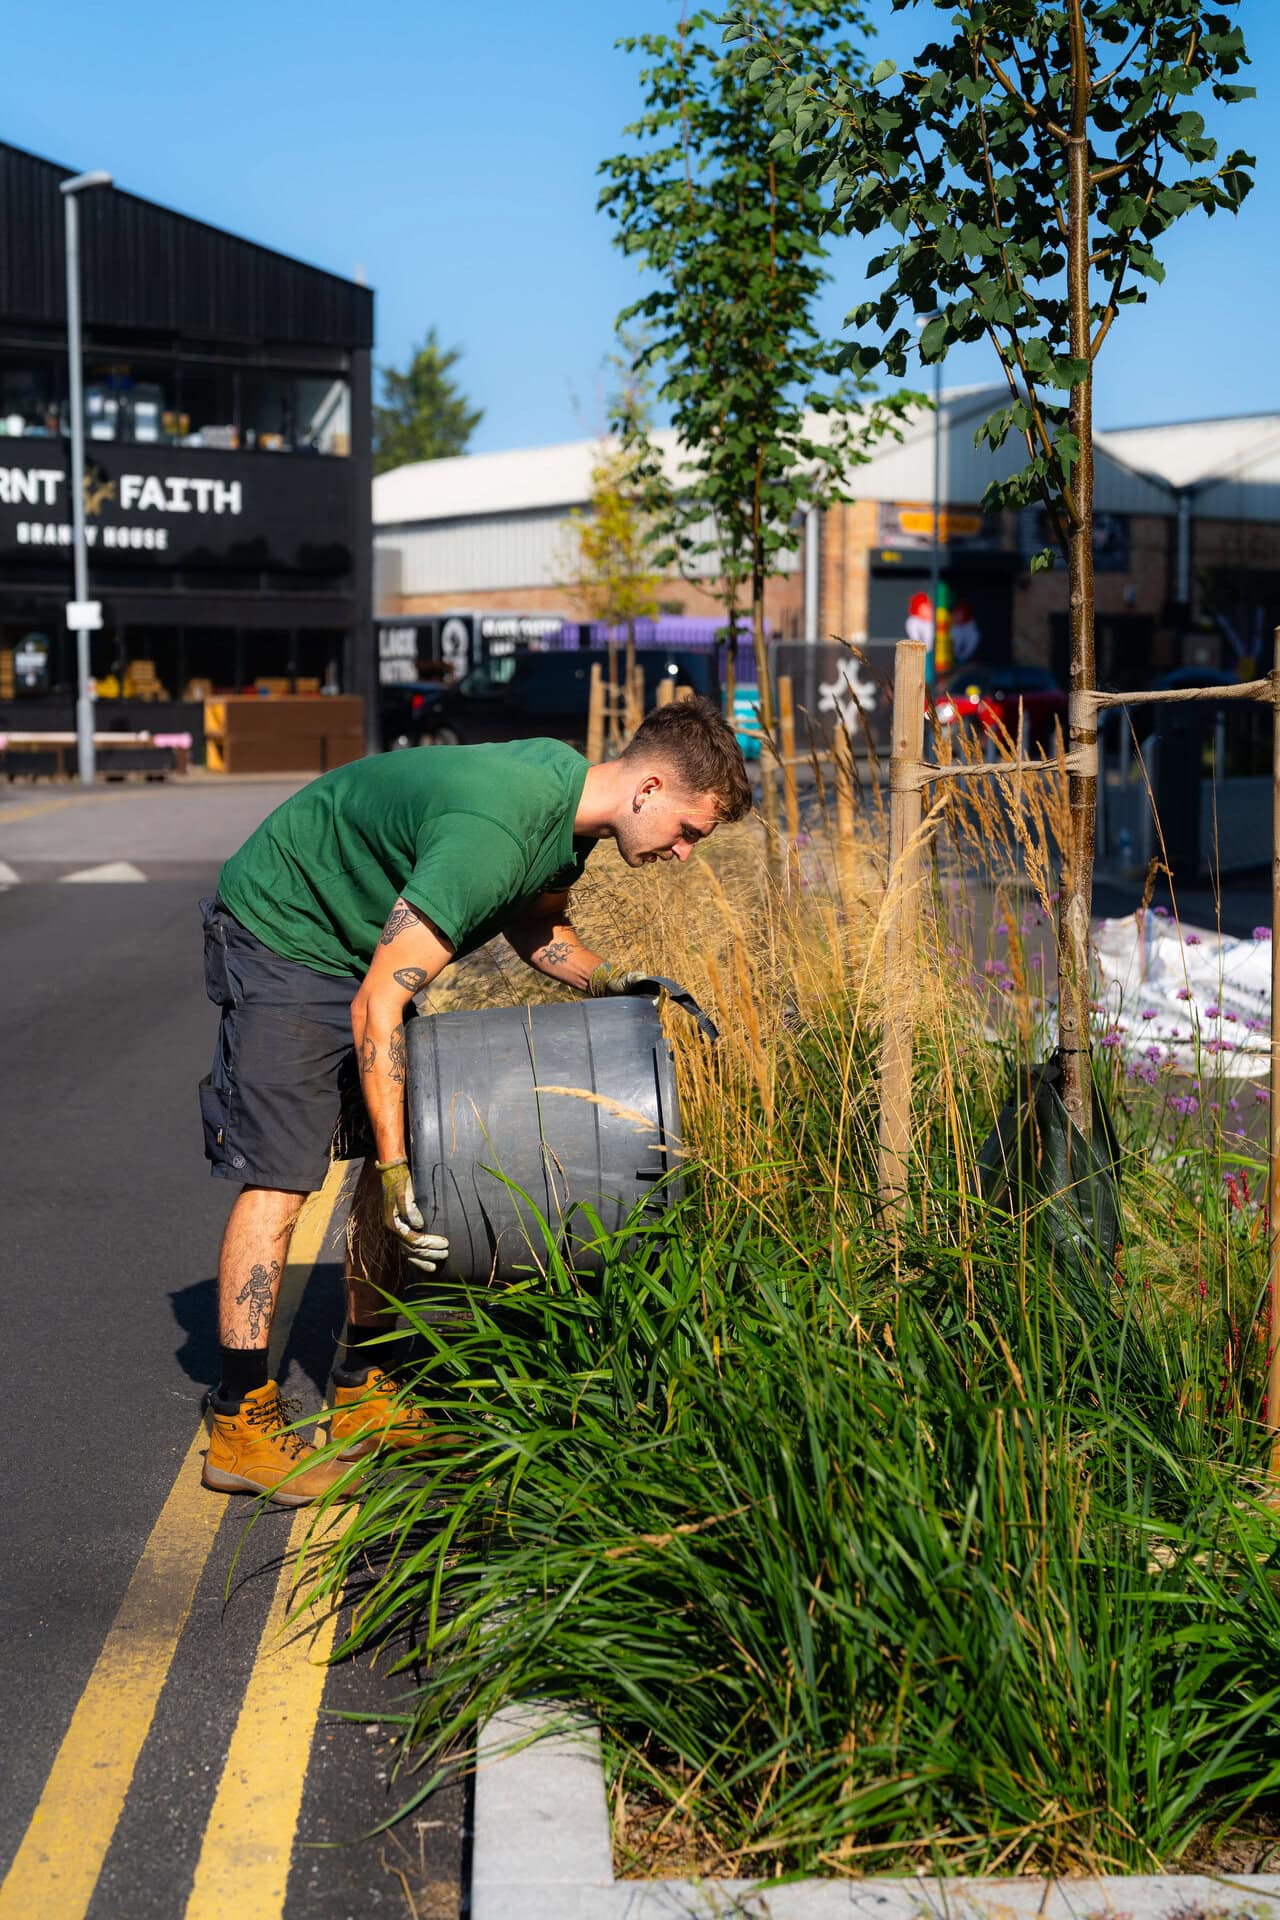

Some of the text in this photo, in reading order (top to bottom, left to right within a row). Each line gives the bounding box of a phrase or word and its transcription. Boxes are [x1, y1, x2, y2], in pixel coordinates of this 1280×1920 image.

[119, 474, 242, 514] FAITH
[16, 522, 168, 550] BRANY HOUSE
